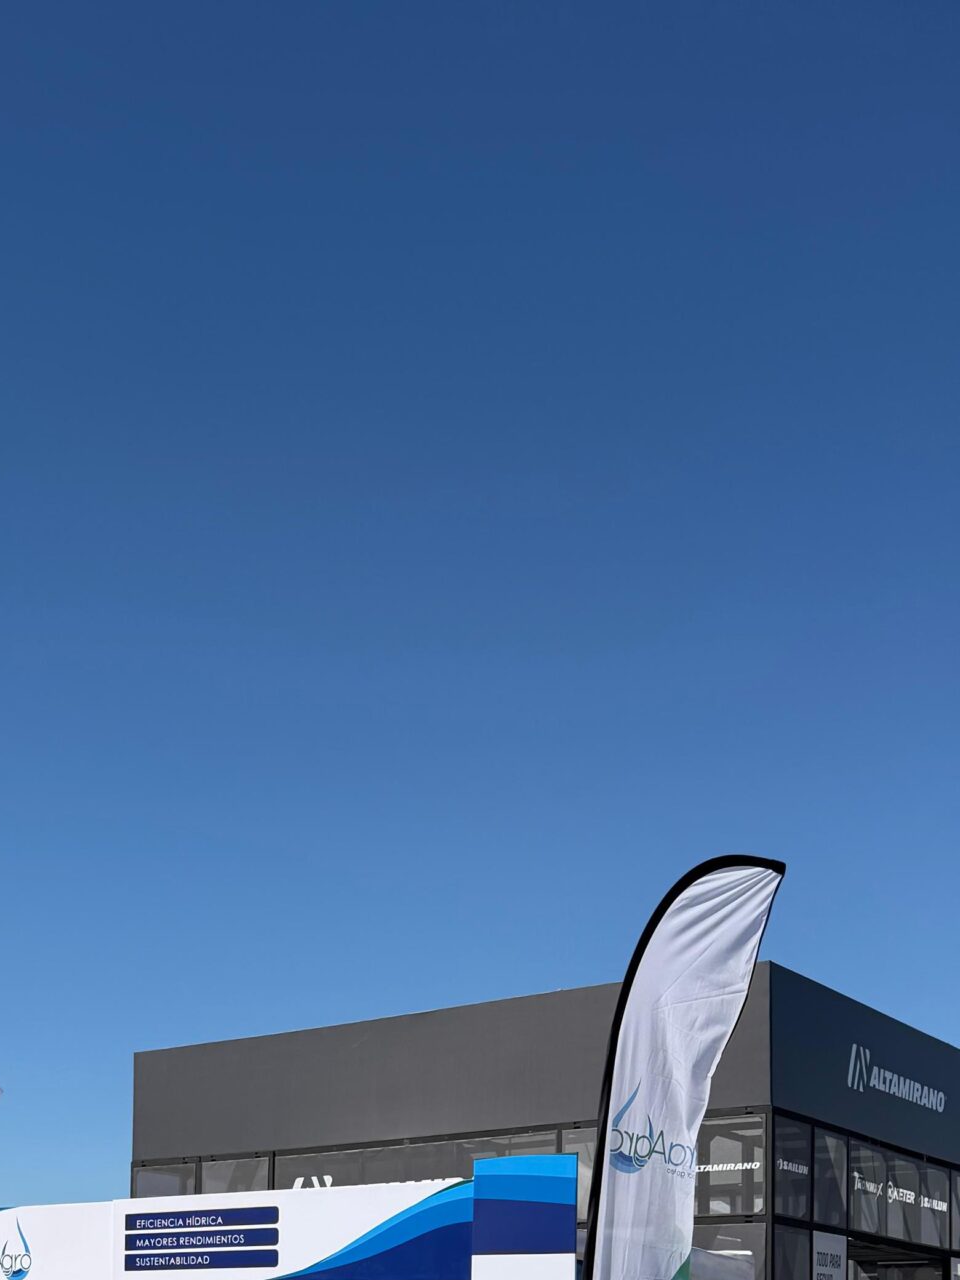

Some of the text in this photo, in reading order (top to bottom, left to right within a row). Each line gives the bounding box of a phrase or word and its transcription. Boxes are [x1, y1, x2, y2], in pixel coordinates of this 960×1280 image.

[869, 1065, 945, 1112] ALTAMIRANO
[893, 1187, 915, 1205] KETER
[136, 1215, 224, 1229] EFICIENCIA HÍDRICA
[136, 1234, 245, 1247] MAYORES RENDIMIENTOS
[136, 1255, 210, 1267] SUSTENTABILIDAD
